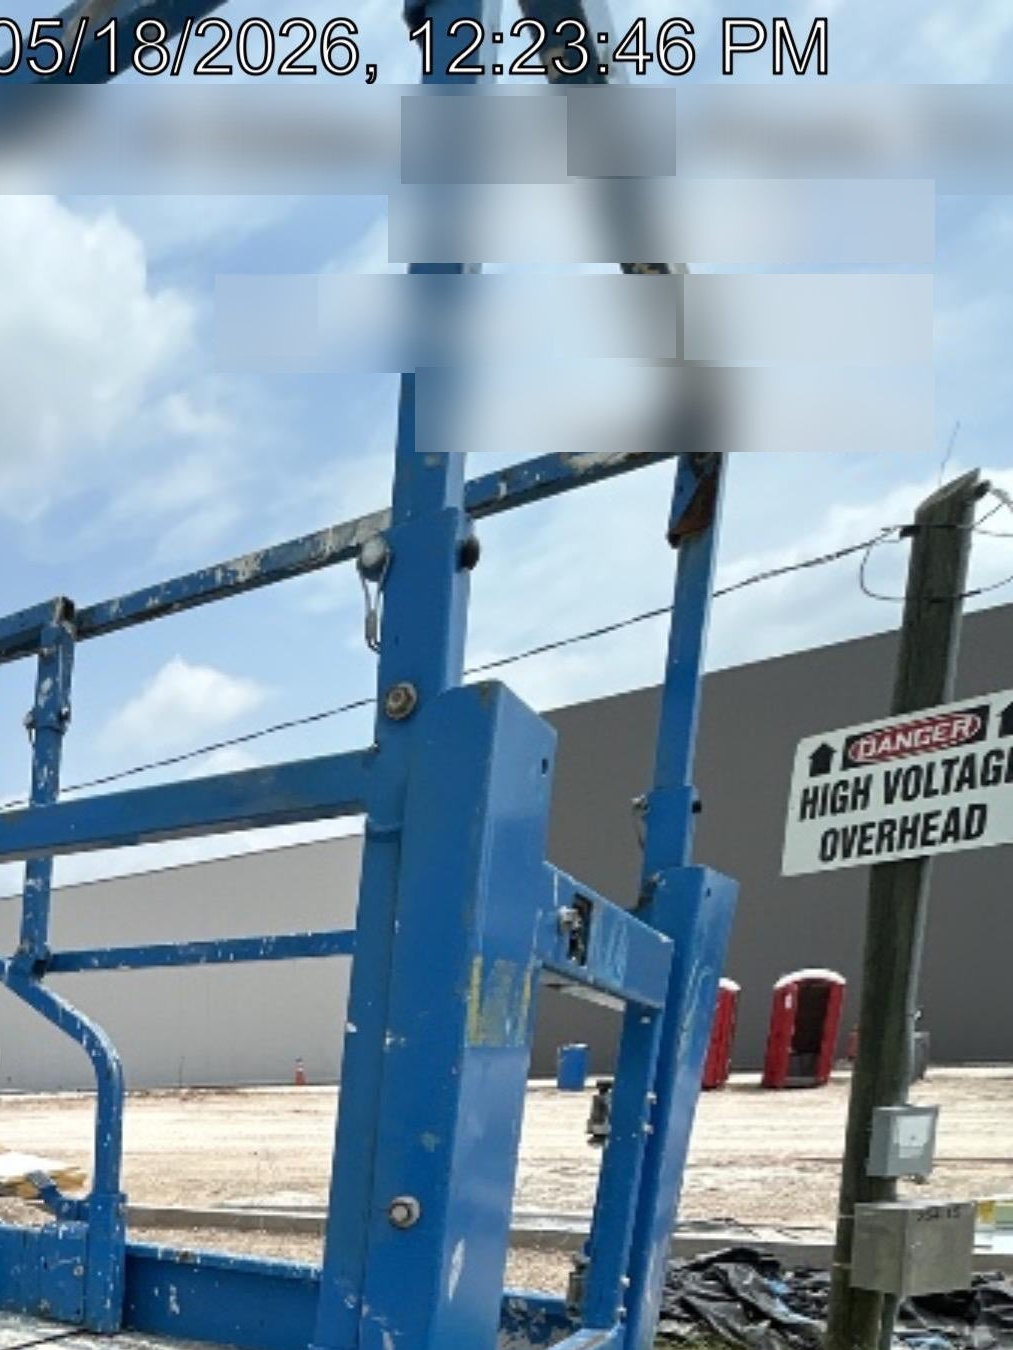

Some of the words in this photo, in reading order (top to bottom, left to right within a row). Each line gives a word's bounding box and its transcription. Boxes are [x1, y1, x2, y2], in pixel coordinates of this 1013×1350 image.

[858, 715, 973, 758] DANGER
[799, 774, 874, 821] HIGH
[819, 804, 987, 863] OVERHEAD
